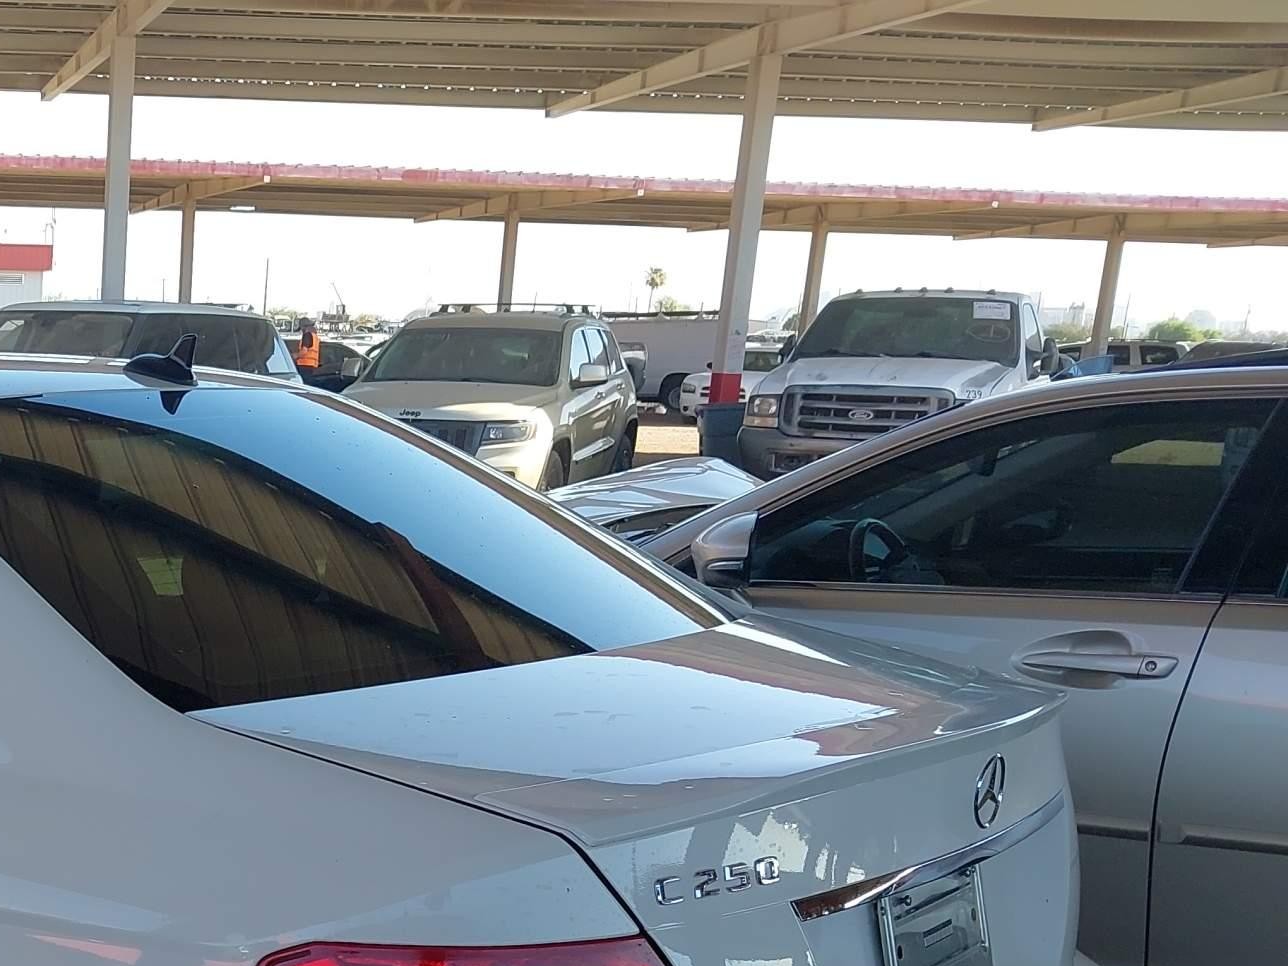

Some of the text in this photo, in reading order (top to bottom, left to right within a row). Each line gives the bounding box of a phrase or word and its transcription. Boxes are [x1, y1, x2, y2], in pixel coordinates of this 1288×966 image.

[966, 389, 983, 399] 239
[399, 408, 421, 418] Jeep
[654, 855, 780, 906] C 250
